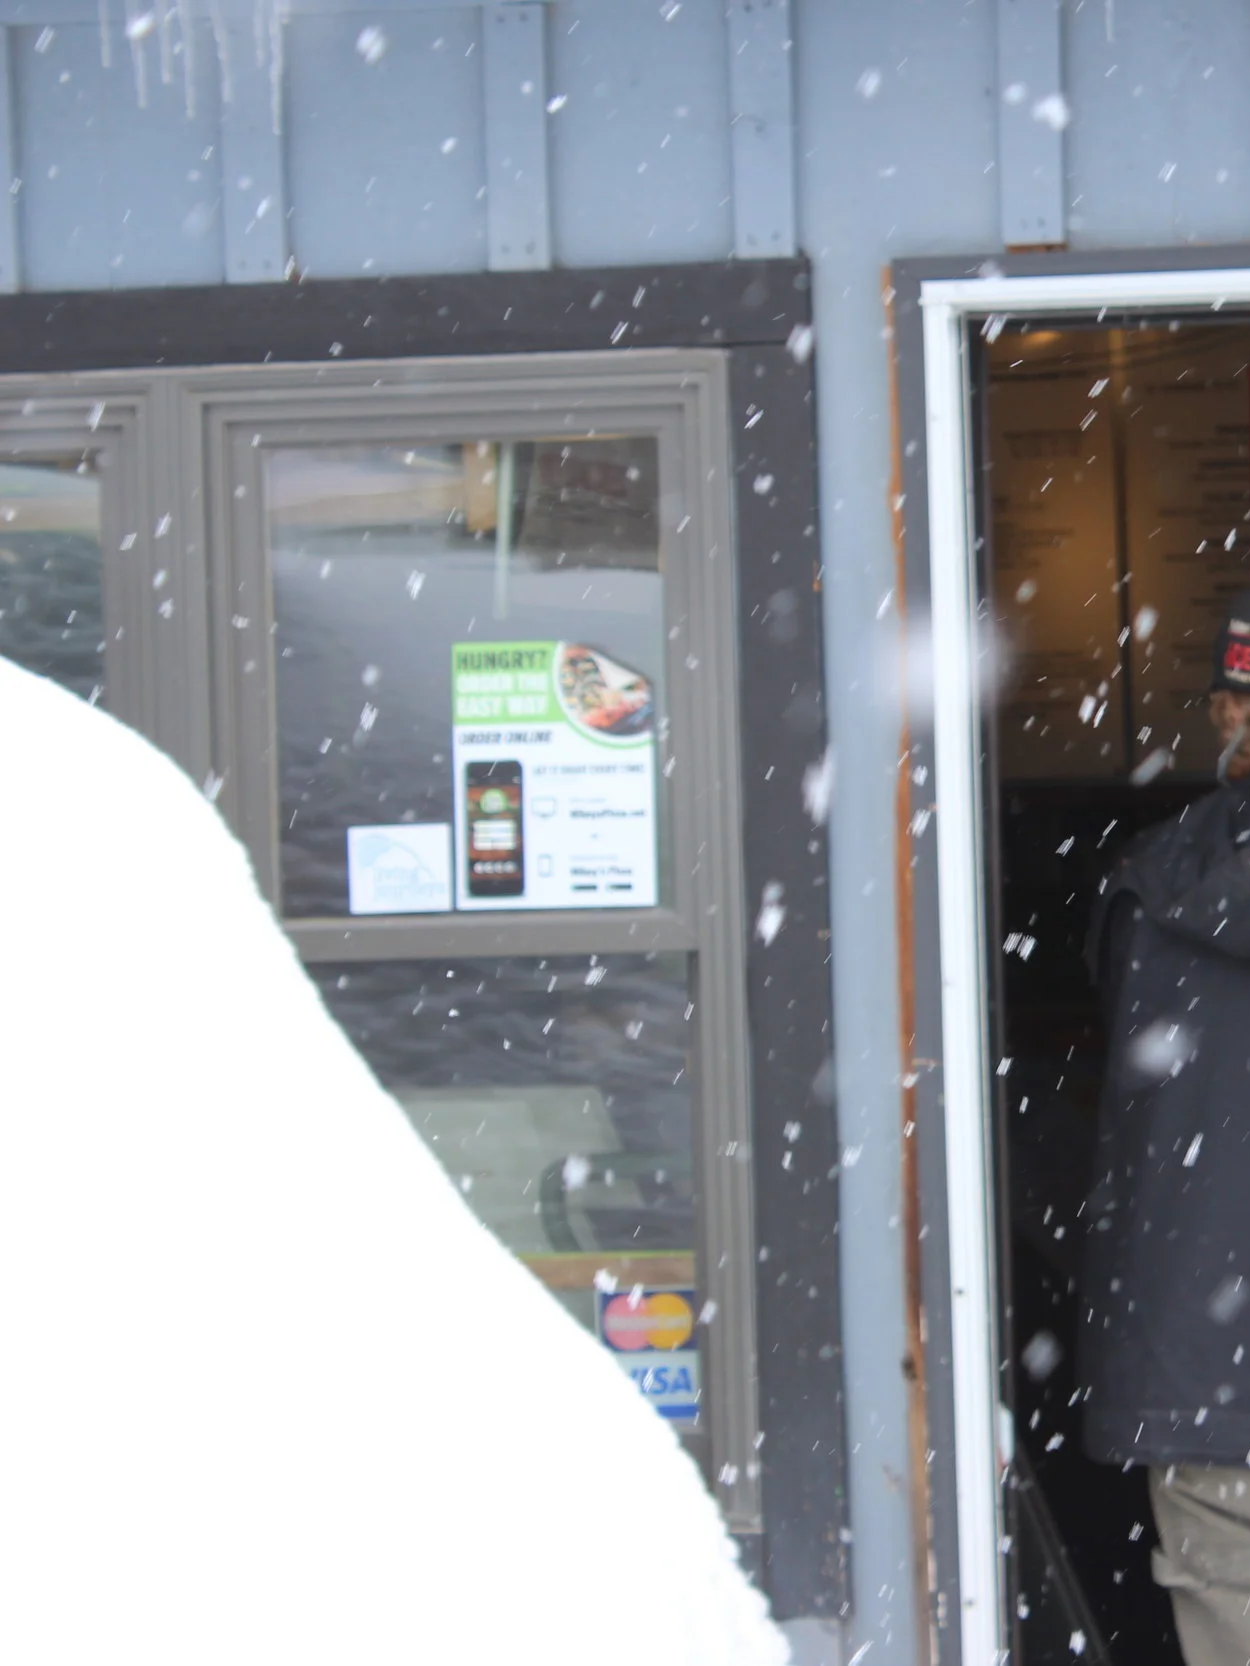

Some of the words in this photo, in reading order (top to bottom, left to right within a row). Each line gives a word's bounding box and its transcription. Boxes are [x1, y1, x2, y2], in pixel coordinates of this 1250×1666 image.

[456, 649, 547, 671] HUNGRY?
[458, 731, 502, 745] ORDER
[506, 729, 553, 744] ONLINE
